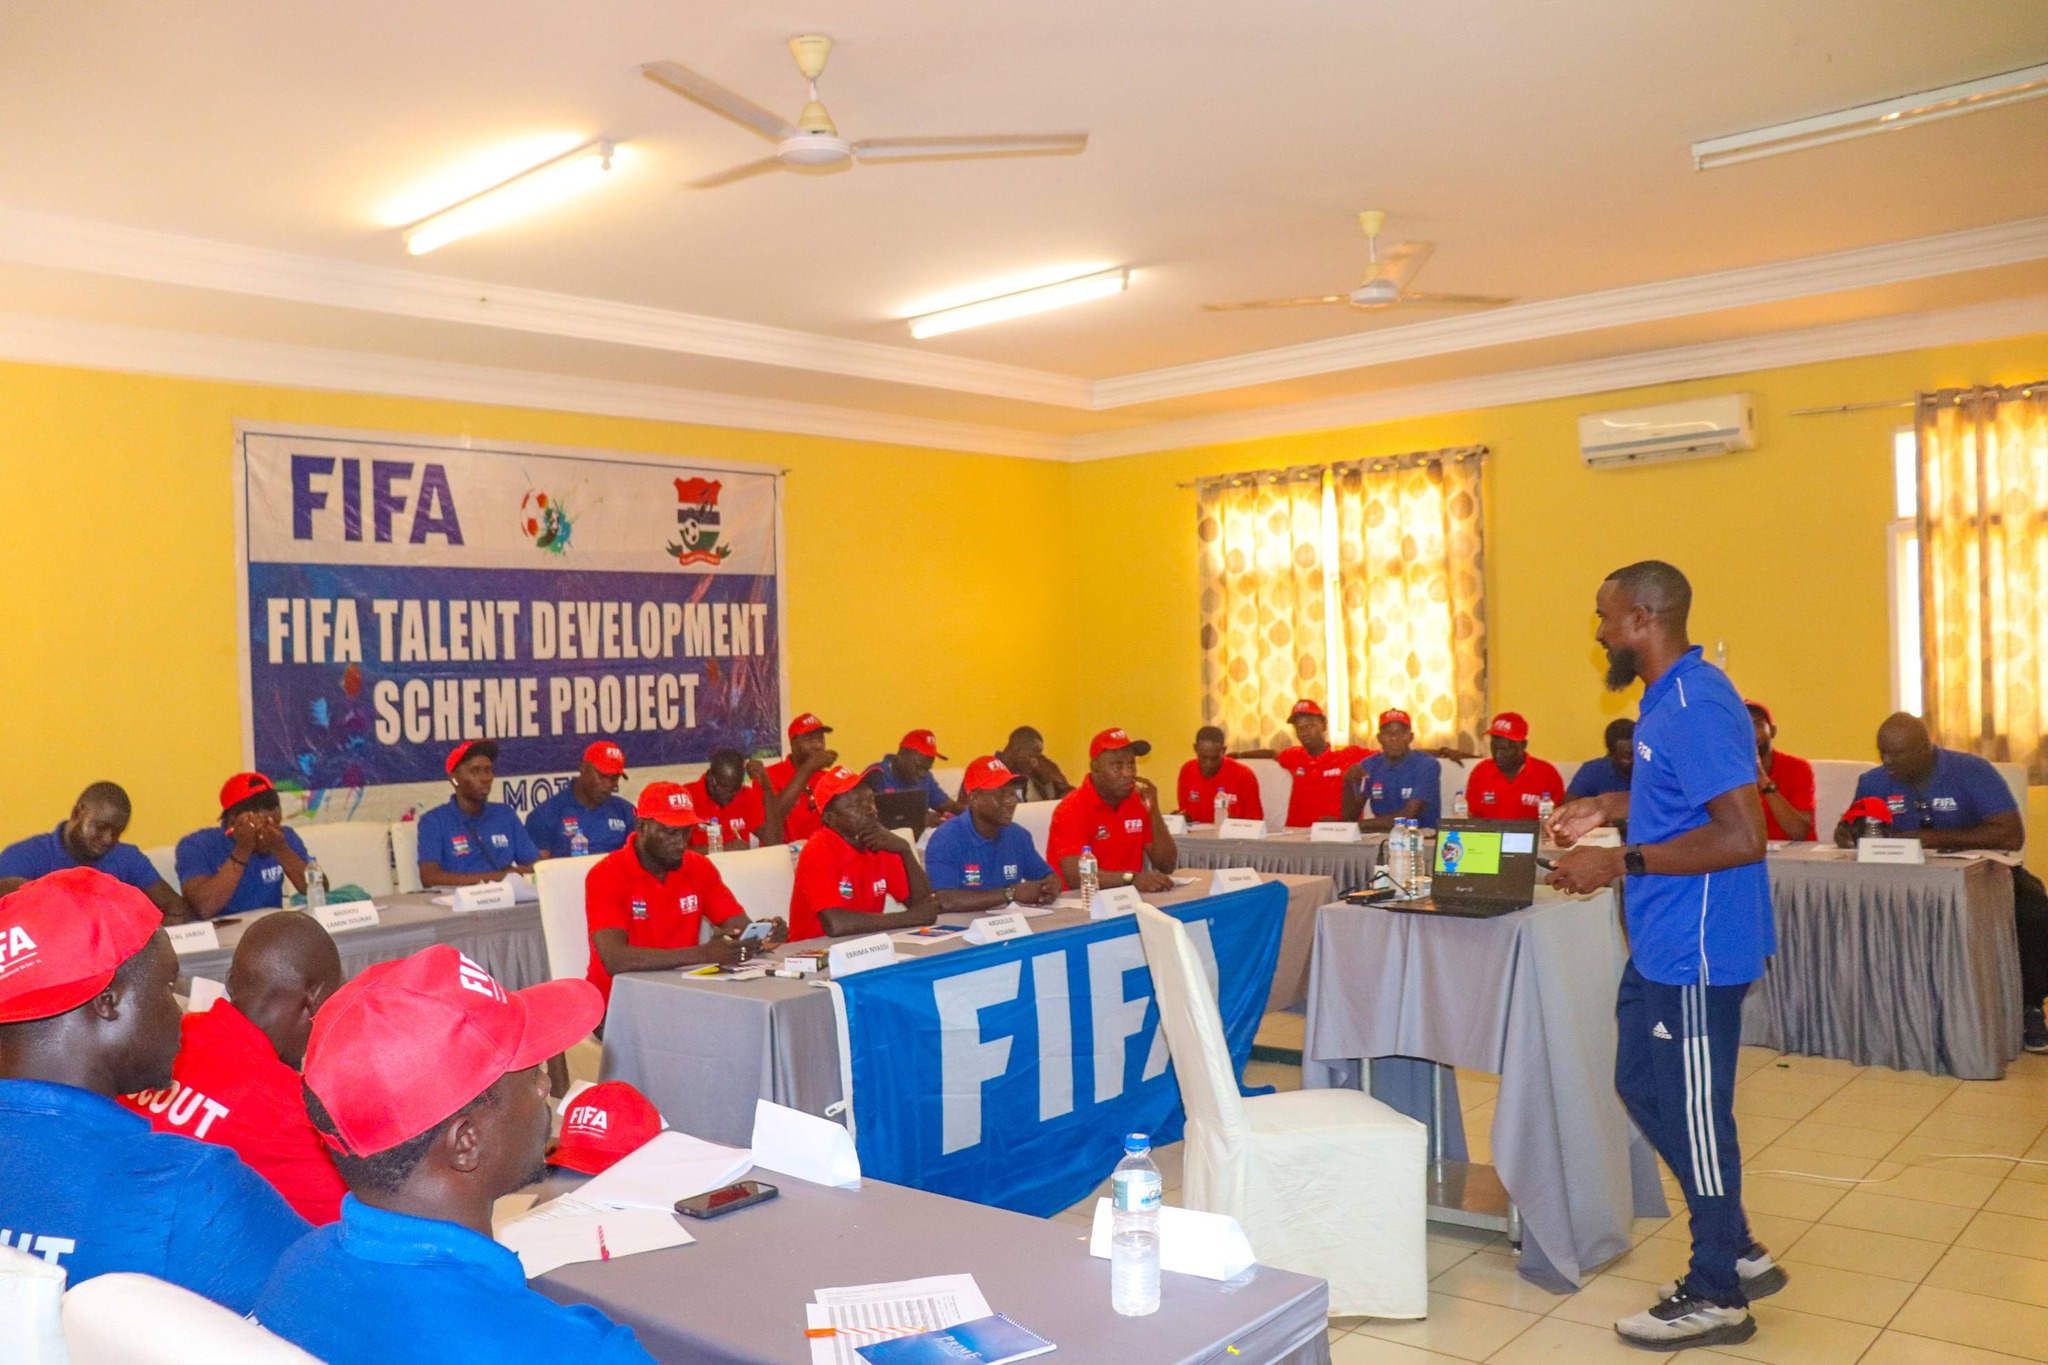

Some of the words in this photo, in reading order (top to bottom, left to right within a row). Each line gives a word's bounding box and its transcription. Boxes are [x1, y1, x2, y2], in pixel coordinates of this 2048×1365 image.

[290, 453, 465, 546] FIFA
[267, 598, 363, 664] FIFA
[373, 599, 520, 662] TALENT
[532, 600, 768, 660] DEVELOPMENT
[373, 678, 540, 746] SCHEME
[551, 672, 700, 736] PROJECT
[1932, 798, 1957, 808] FIFA
[845, 948, 870, 959] EBRIMA
[869, 943, 889, 953] NYASSI
[568, 1105, 608, 1130] FIFA
